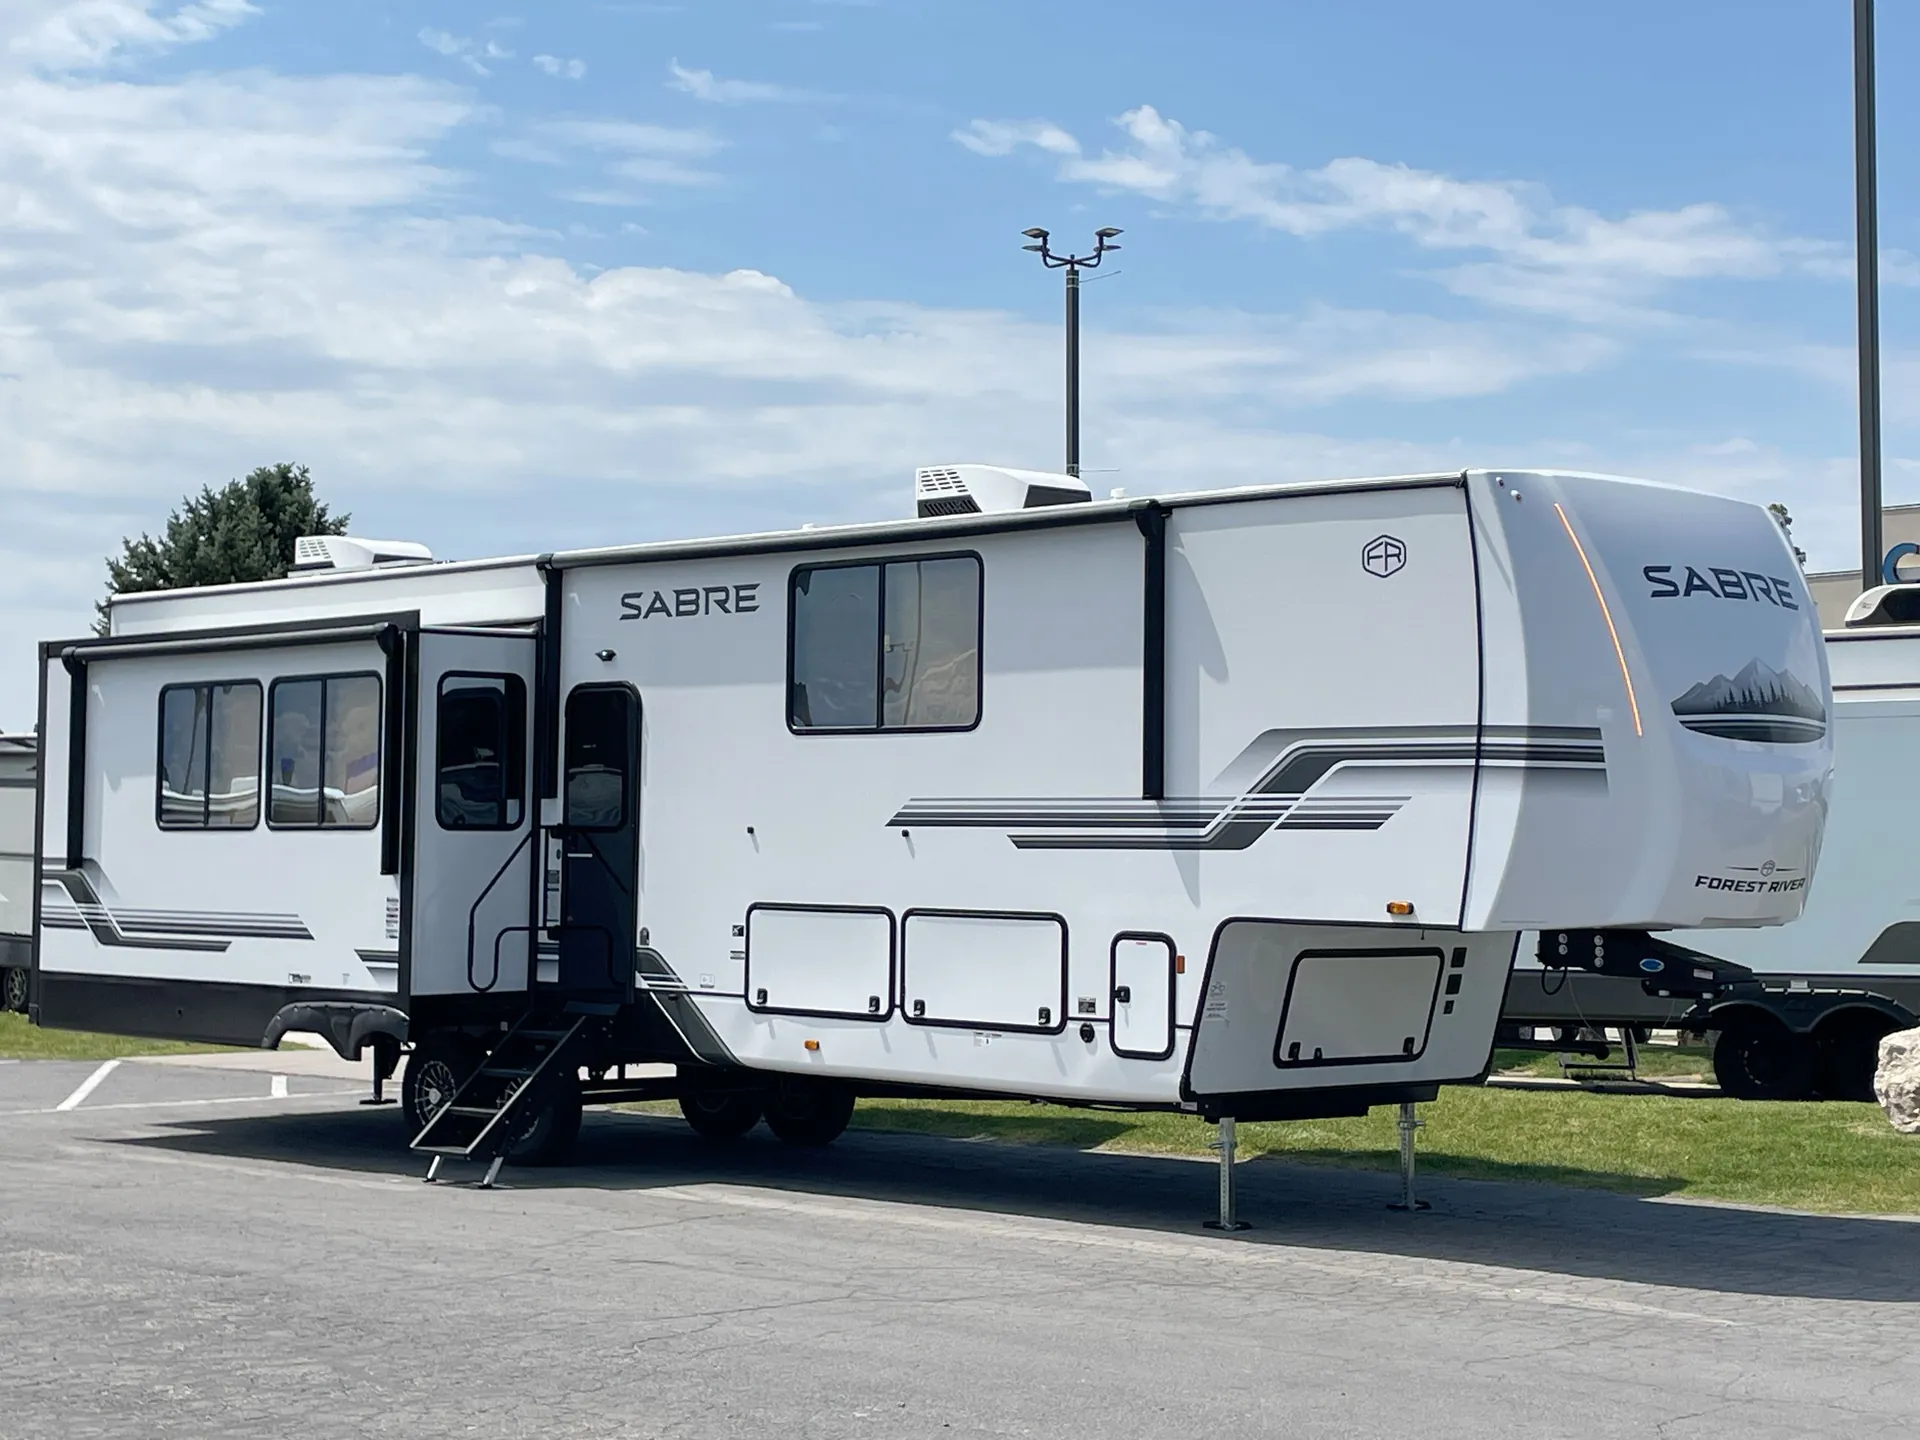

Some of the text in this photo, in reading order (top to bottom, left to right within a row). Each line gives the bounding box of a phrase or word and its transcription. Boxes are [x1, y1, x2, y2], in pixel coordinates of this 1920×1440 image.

[619, 582, 762, 621] SABRE
[1643, 565, 1799, 611] SABRE
[1694, 875, 1806, 893] FOREST RIVER
